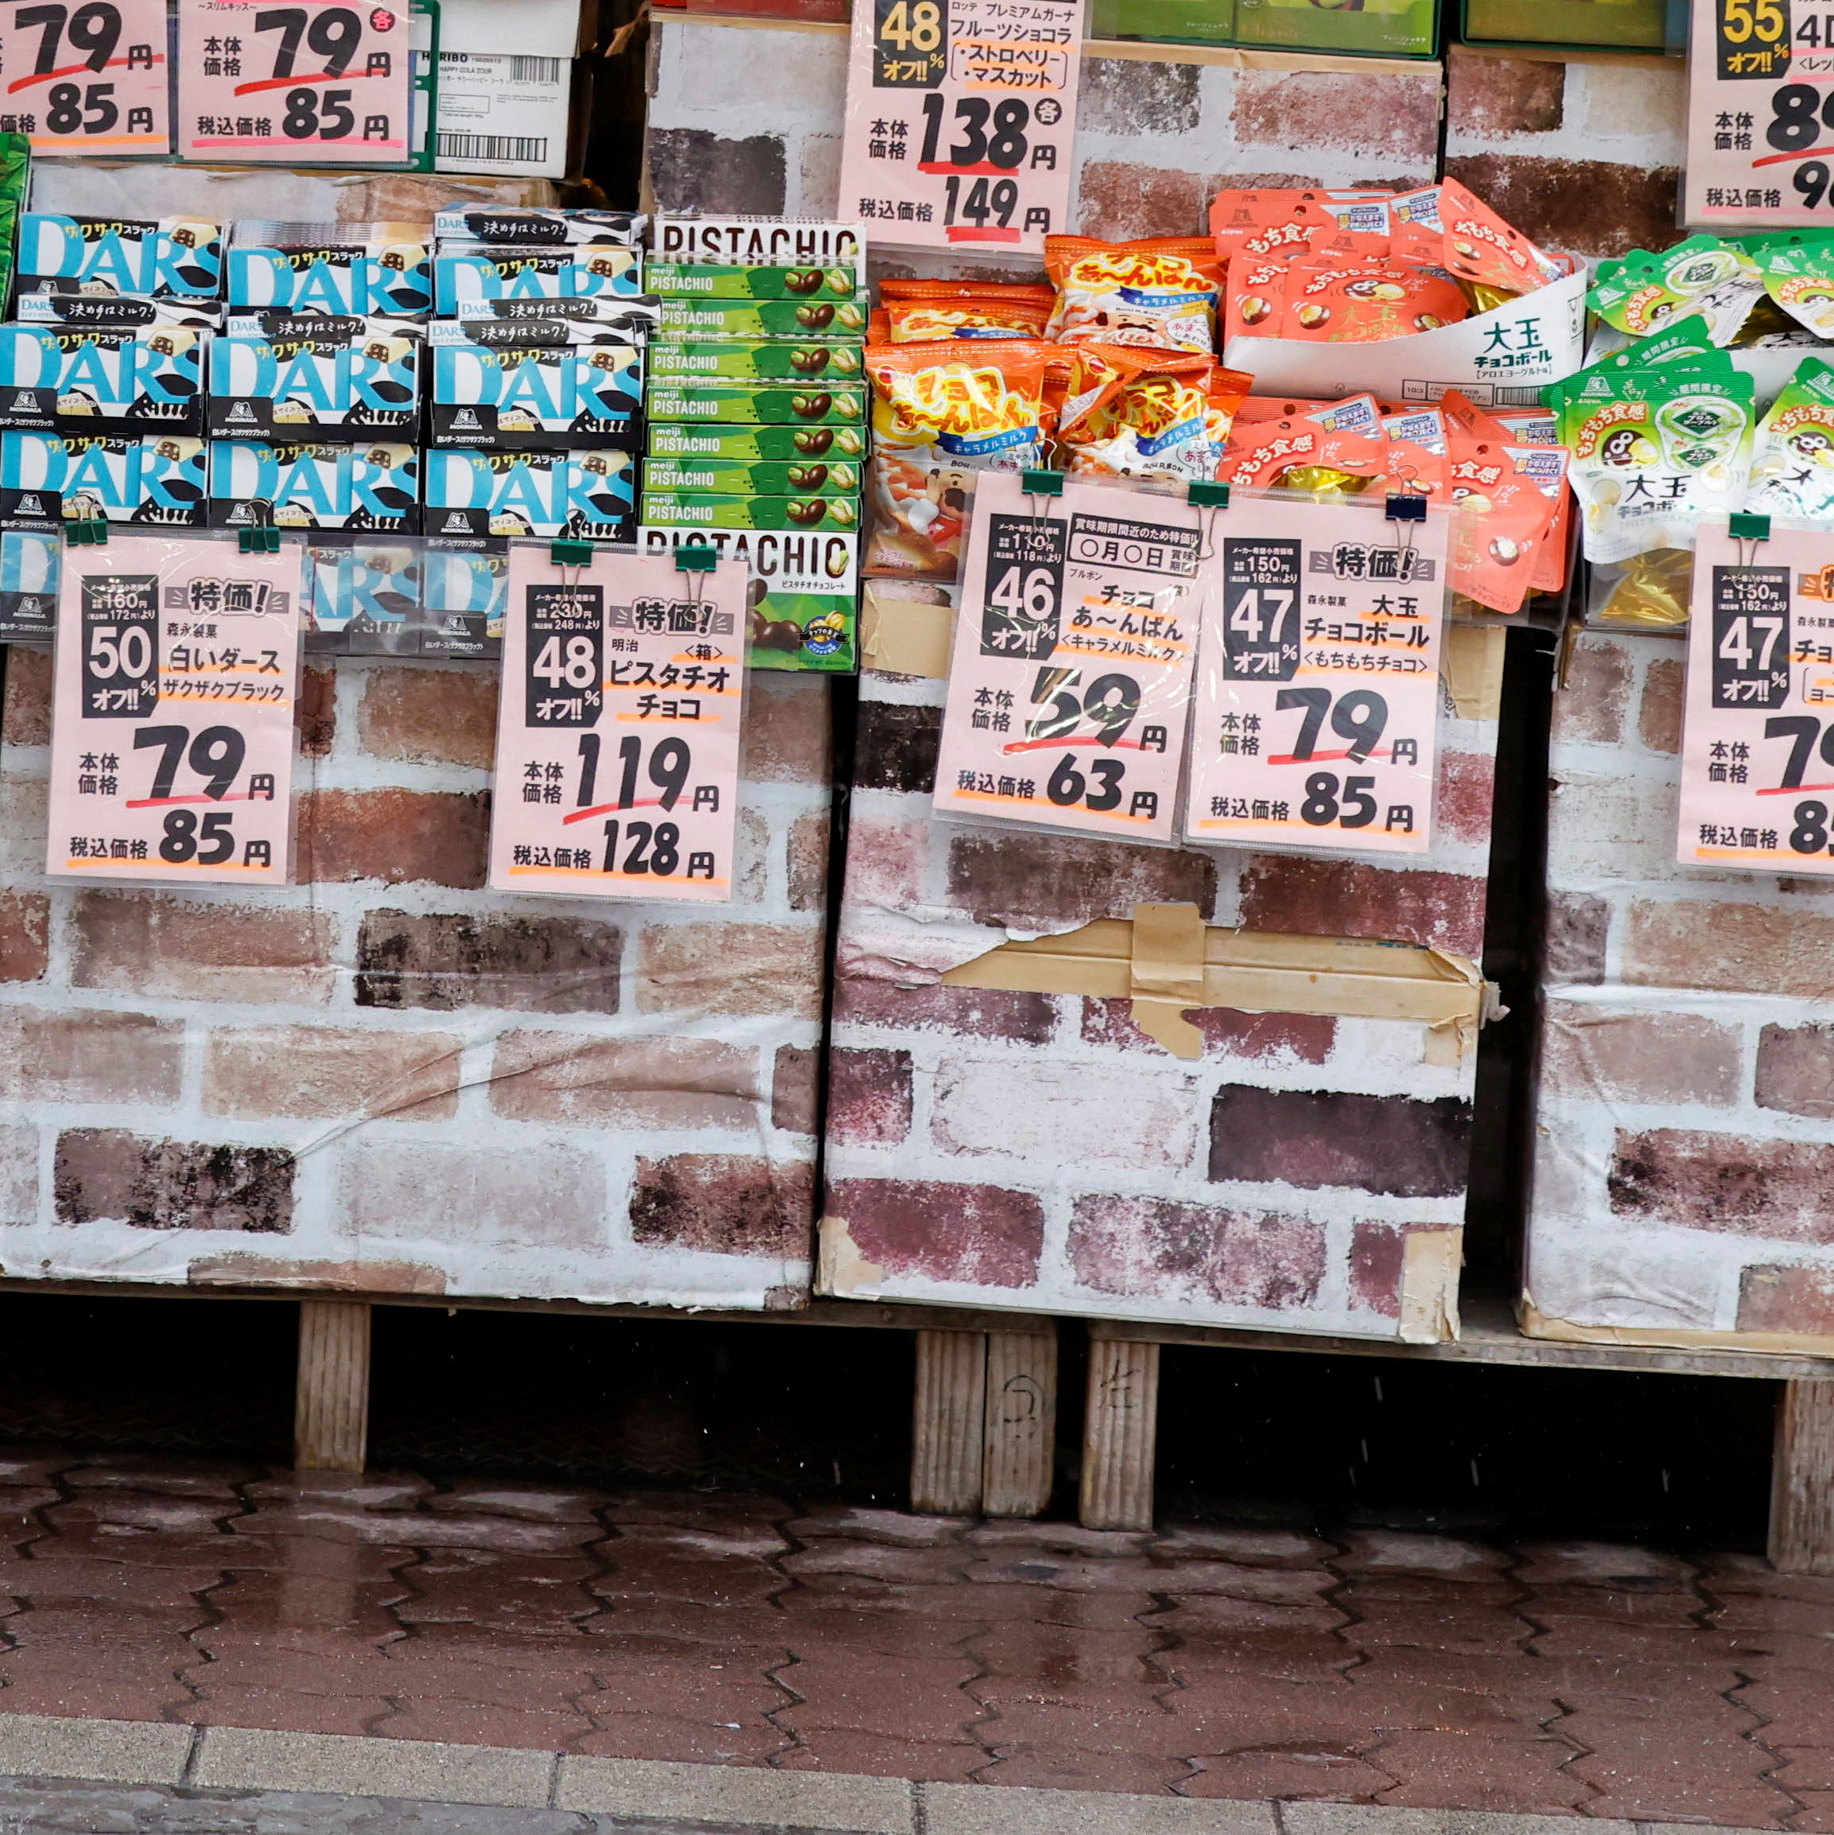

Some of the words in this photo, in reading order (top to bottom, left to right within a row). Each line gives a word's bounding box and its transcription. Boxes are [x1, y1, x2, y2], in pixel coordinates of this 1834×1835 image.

[986, 3, 1075, 21] プレミアムガーナ
[880, 1, 941, 52] 48
[951, 19, 1072, 45] フルーツショコラ
[422, 53, 468, 63] HRIBO
[859, 198, 933, 221] 税込価格
[651, 276, 714, 292] PISTACHIO
[1483, 318, 1541, 355] 大玉
[1475, 345, 1553, 368] チョコボール
[190, 581, 265, 612] 特価!
[991, 567, 1054, 620] 46
[1101, 584, 1155, 609] チョコ
[1230, 589, 1295, 644] 47
[1371, 596, 1419, 619] 大玉
[166, 622, 218, 640] 森永製菓
[1305, 618, 1429, 648] チョコボール
[1719, 616, 1783, 671] 47
[88, 626, 152, 679] 50
[167, 646, 281, 674] 白いダース
[533, 636, 598, 690] 48
[611, 662, 731, 690] ピスタチオ
[164, 678, 284, 703] ザクザクブラック
[637, 694, 702, 721] チョコ
[70, 836, 148, 860] 税込価格
[1699, 824, 1778, 849] 税込価格
